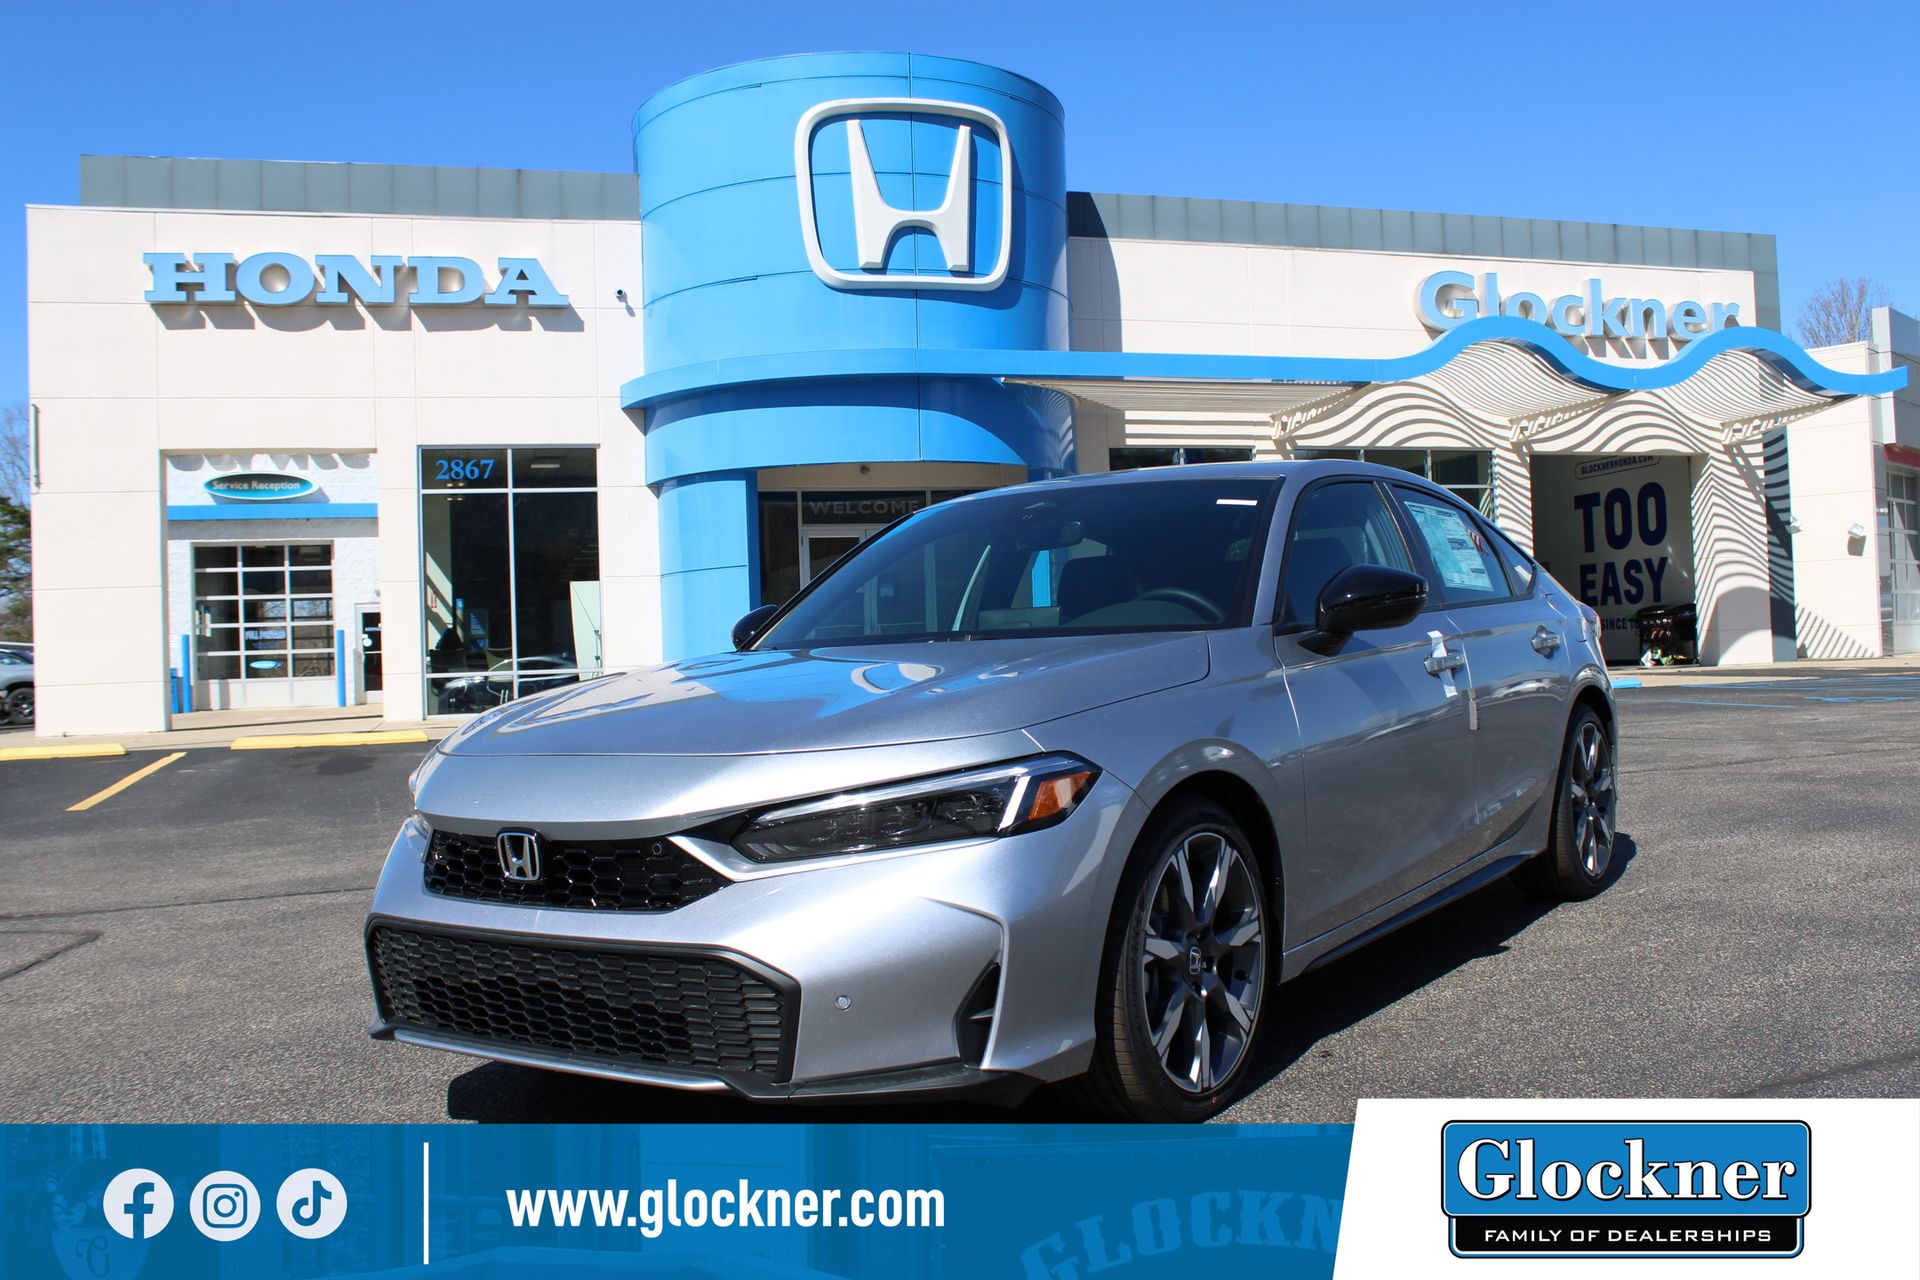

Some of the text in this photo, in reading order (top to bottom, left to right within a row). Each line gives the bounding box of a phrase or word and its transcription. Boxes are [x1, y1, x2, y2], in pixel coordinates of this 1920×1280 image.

[143, 252, 569, 306] HONDA
[1417, 270, 1741, 339] Glockner
[212, 480, 301, 492] Service Reception
[435, 459, 495, 481] 2867
[809, 500, 920, 515] WELCOME
[1573, 481, 1668, 554] TOO
[1579, 556, 1669, 607] EASY
[1601, 617, 1628, 631] SINCE
